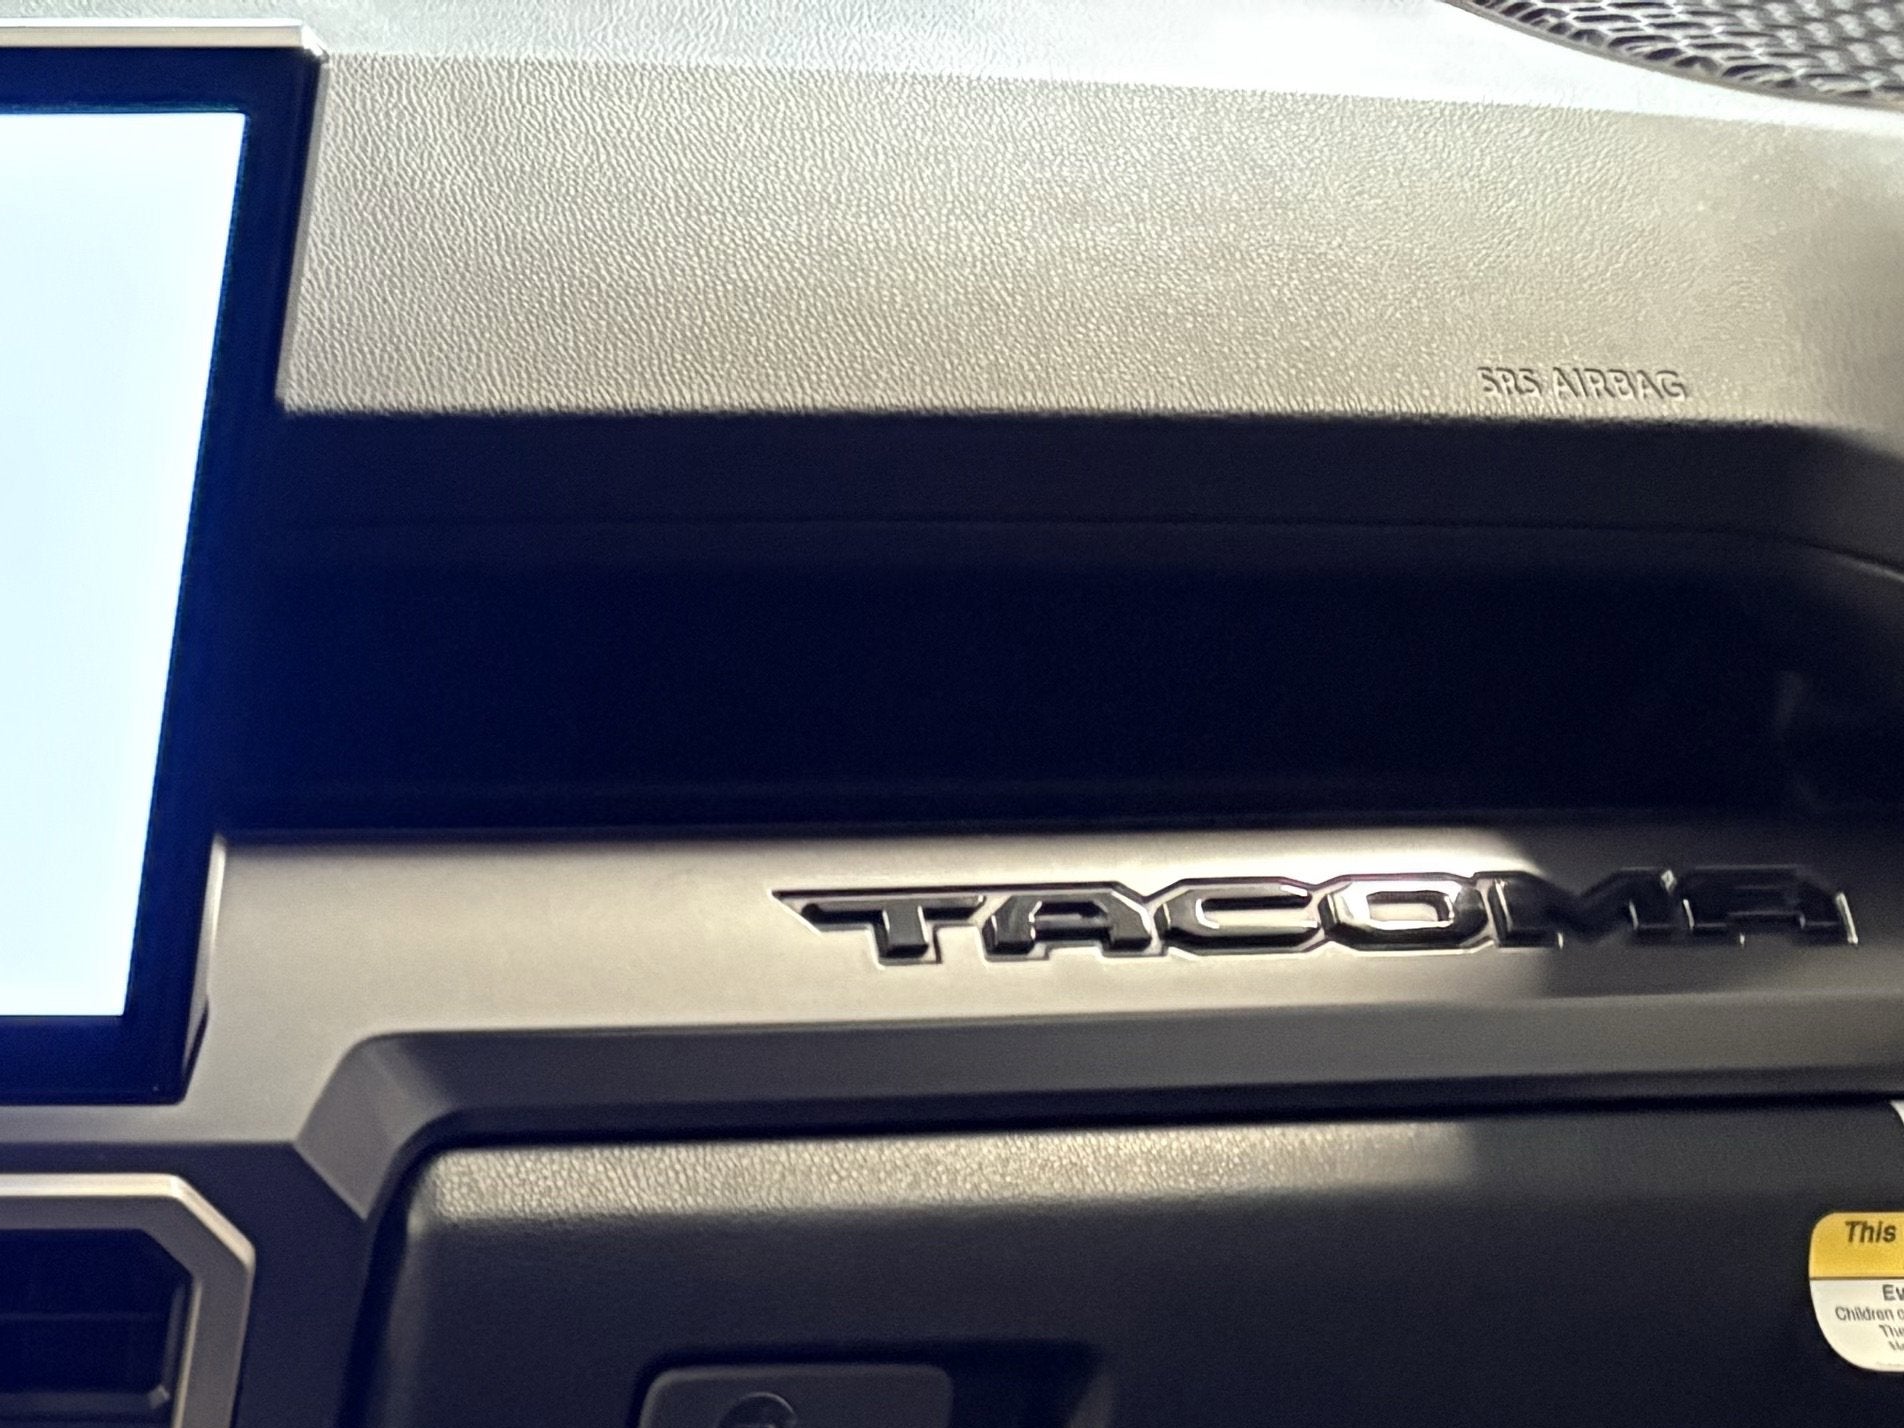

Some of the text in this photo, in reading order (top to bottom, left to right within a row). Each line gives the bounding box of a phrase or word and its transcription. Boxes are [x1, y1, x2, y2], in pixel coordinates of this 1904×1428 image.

[1477, 367, 1688, 400] SRS AIRBAG
[772, 869, 1859, 966] TACOMA
[1845, 1221, 1896, 1243] This
[1835, 1306, 1895, 1321] Children
